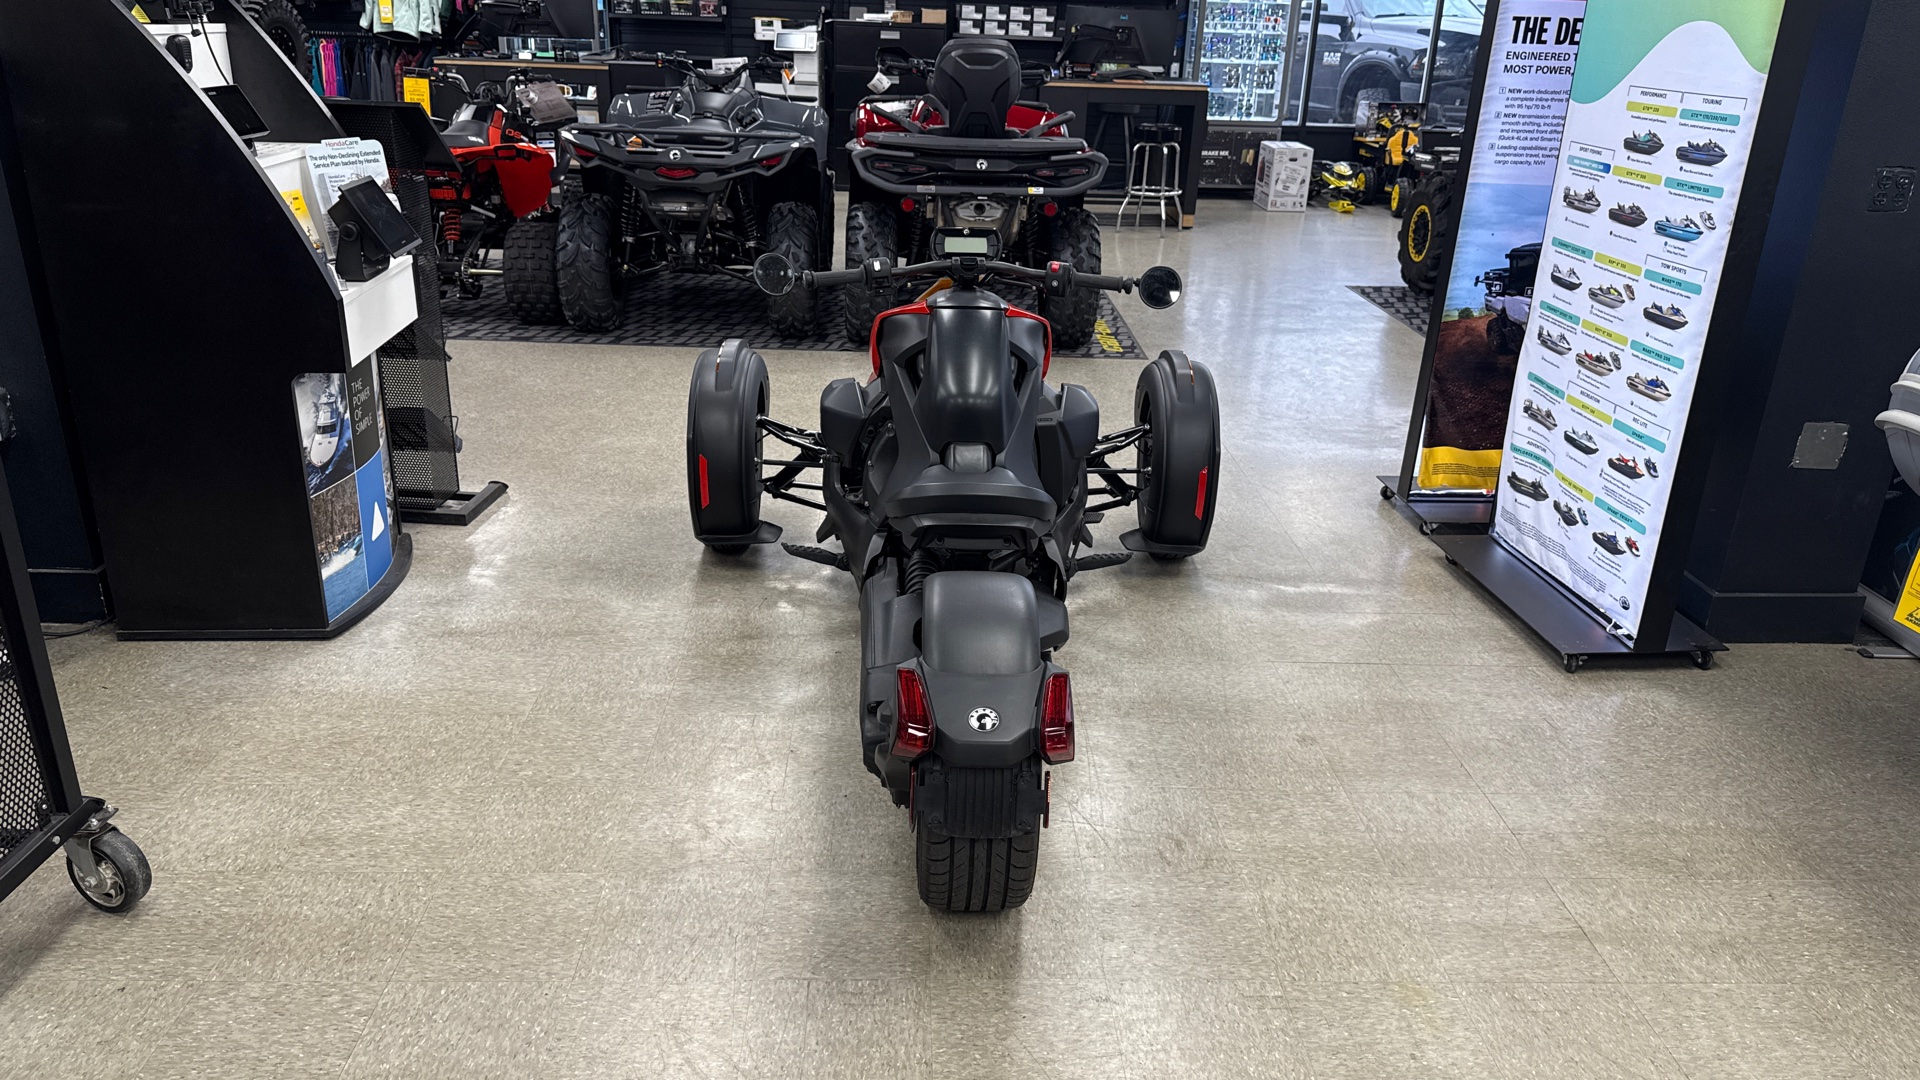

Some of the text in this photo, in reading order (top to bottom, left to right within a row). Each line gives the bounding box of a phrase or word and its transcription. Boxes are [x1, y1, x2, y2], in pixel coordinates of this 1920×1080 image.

[1512, 16, 1584, 45] THE DE
[1506, 51, 1570, 61] ENGINEERED
[1503, 64, 1574, 76] MOST POWER,
[1640, 91, 1667, 99] PERFORMANCE
[328, 152, 360, 160] Non-Declining
[1661, 263, 1687, 275] TOW SPORTS
[351, 378, 362, 394] THE
[353, 386, 370, 408] POWER
[355, 407, 362, 421] OF
[356, 413, 373, 435] SIMPLE
[1513, 447, 1533, 458] EXPLORER
[1526, 440, 1547, 454] ADVENTURE
